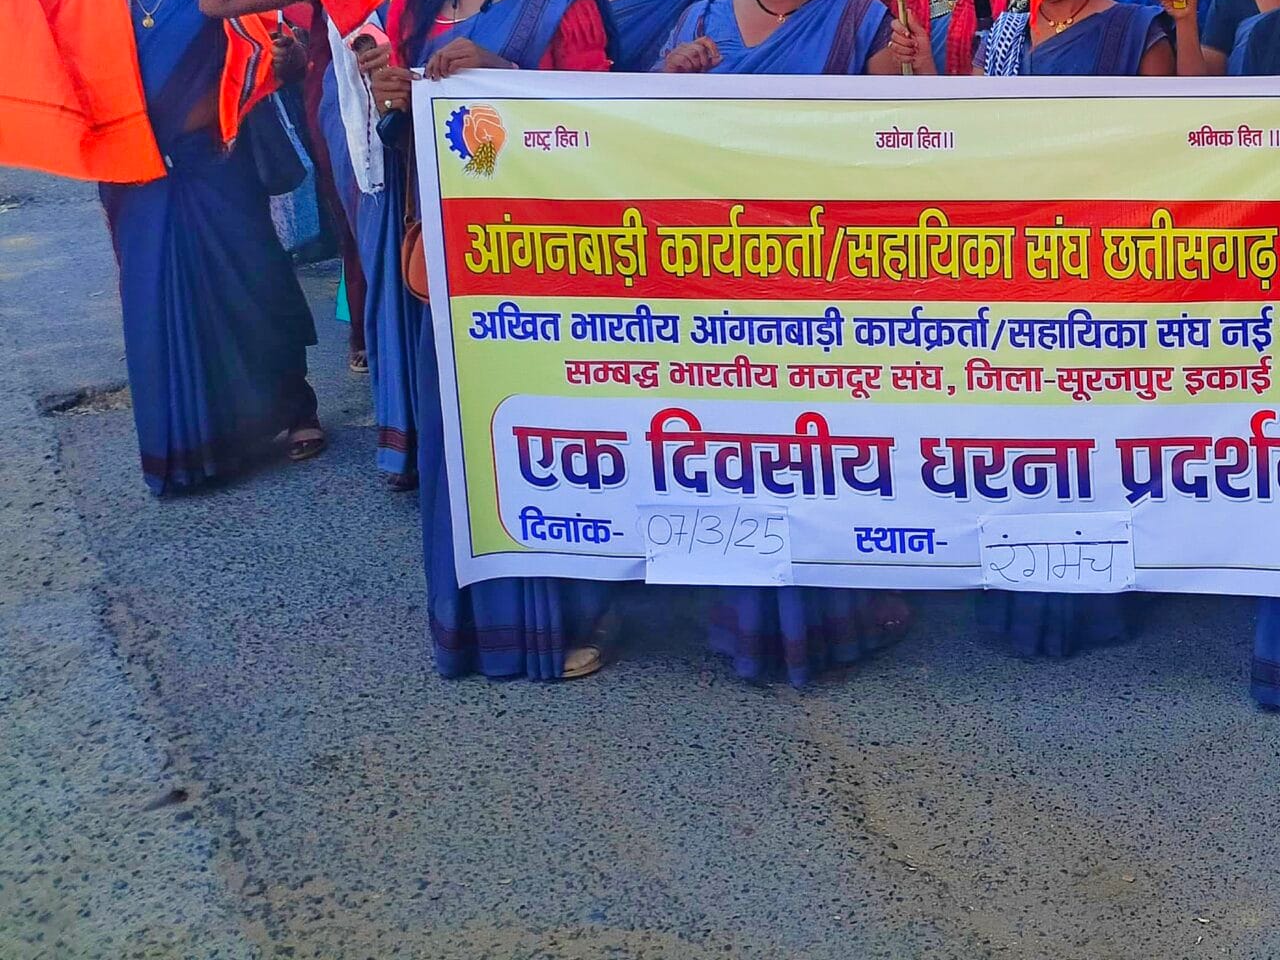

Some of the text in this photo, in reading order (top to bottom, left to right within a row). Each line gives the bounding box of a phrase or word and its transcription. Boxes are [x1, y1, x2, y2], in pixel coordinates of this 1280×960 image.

[523, 128, 551, 151] राष्ट्र
[555, 127, 579, 149] हित
[875, 127, 913, 150] उद्योग
[1187, 125, 1234, 148] श्रमिक
[1238, 125, 1263, 147] हित
[465, 206, 648, 287] आंगनबाड़ी
[1026, 215, 1091, 280] संघ
[1102, 207, 1279, 290] छत्तीसगढ़
[571, 304, 680, 344] भारतीय
[691, 306, 844, 352] आंगनबाड़ी
[1156, 315, 1211, 349] संघ
[1220, 306, 1275, 353] नई
[565, 359, 661, 388] सम्बद्ध
[670, 355, 778, 389] भारतीय
[787, 364, 883, 398] मजदूर
[965, 357, 1175, 401] जिला-सूरजपुर
[1183, 355, 1272, 396] इकाई
[512, 426, 628, 491] एक
[646, 407, 895, 498] दिवसीय
[919, 437, 1096, 501] धरना
[519, 506, 624, 544] दिनांक-
[646, 506, 785, 556] 07/3/25
[854, 526, 948, 555] स्थान-
[984, 530, 1129, 584] रंगमंच
